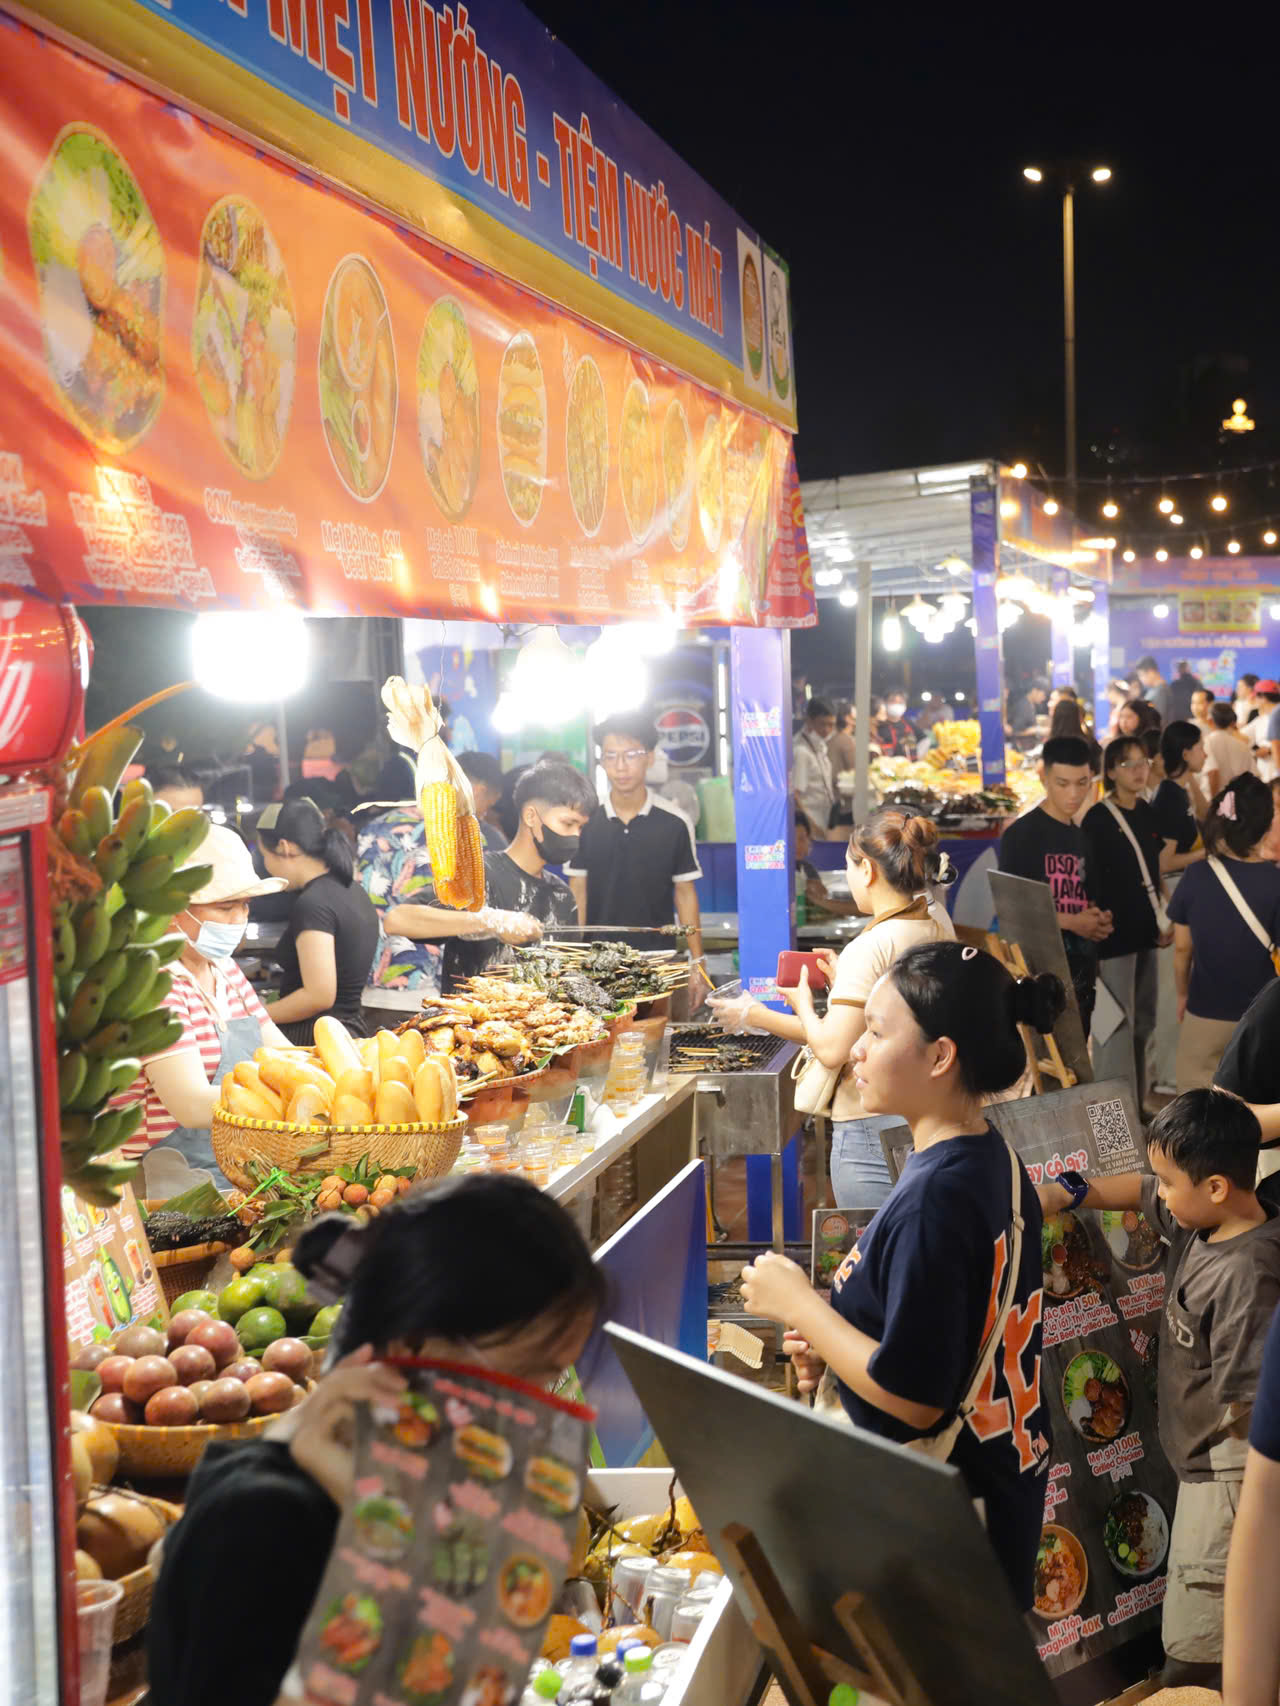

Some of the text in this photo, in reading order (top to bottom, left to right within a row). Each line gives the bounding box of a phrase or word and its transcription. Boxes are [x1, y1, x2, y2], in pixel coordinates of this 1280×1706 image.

[388, 0, 532, 212] NƯỚNG
[552, 111, 623, 281] TIỆM
[623, 172, 685, 312] NƯỚC
[684, 219, 725, 338] MÁT
[1026, 1164, 1043, 1184] ay
[1046, 1154, 1064, 1177] có
[1128, 1275, 1151, 1292] 100K
[1123, 1305, 1145, 1319] Honey
[1059, 1328, 1075, 1341] Beef
[1103, 1314, 1118, 1326] Pork
[1114, 1432, 1142, 1452] 100K
[1093, 1449, 1144, 1475] Grilled Chicken
[1148, 1578, 1166, 1592] nướn
[1108, 1606, 1134, 1625] Grilled
[1134, 1599, 1152, 1613] Pork
[1081, 1616, 1102, 1635] 40K
[1039, 1631, 1078, 1658] paghetti
